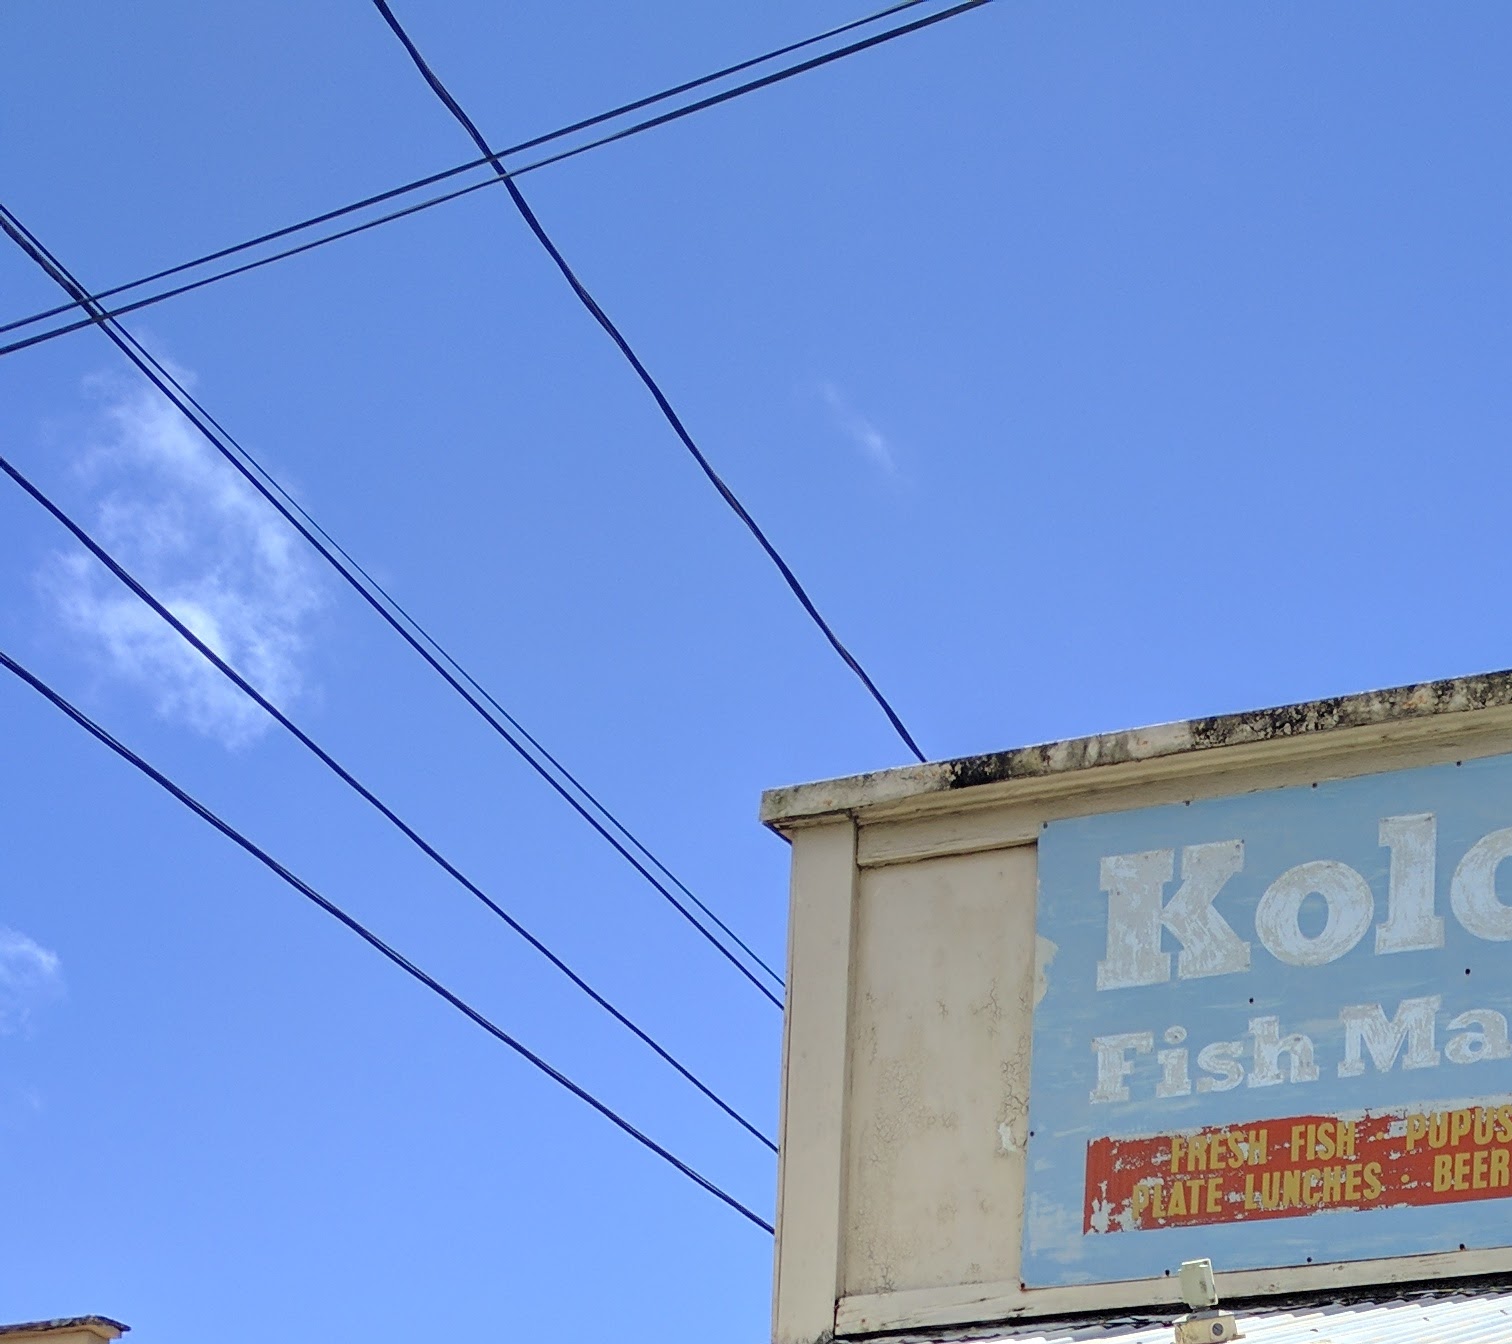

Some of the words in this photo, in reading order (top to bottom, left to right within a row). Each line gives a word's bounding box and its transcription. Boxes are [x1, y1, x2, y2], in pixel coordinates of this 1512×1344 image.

[1090, 1015, 1320, 1102] Fish
[1171, 1129, 1268, 1173] FRESH
[1290, 1121, 1356, 1162] FISH
[1133, 1177, 1223, 1220] PLATE
[1245, 1161, 1383, 1211] LUNCHES
[1433, 1149, 1510, 1192] BEER
